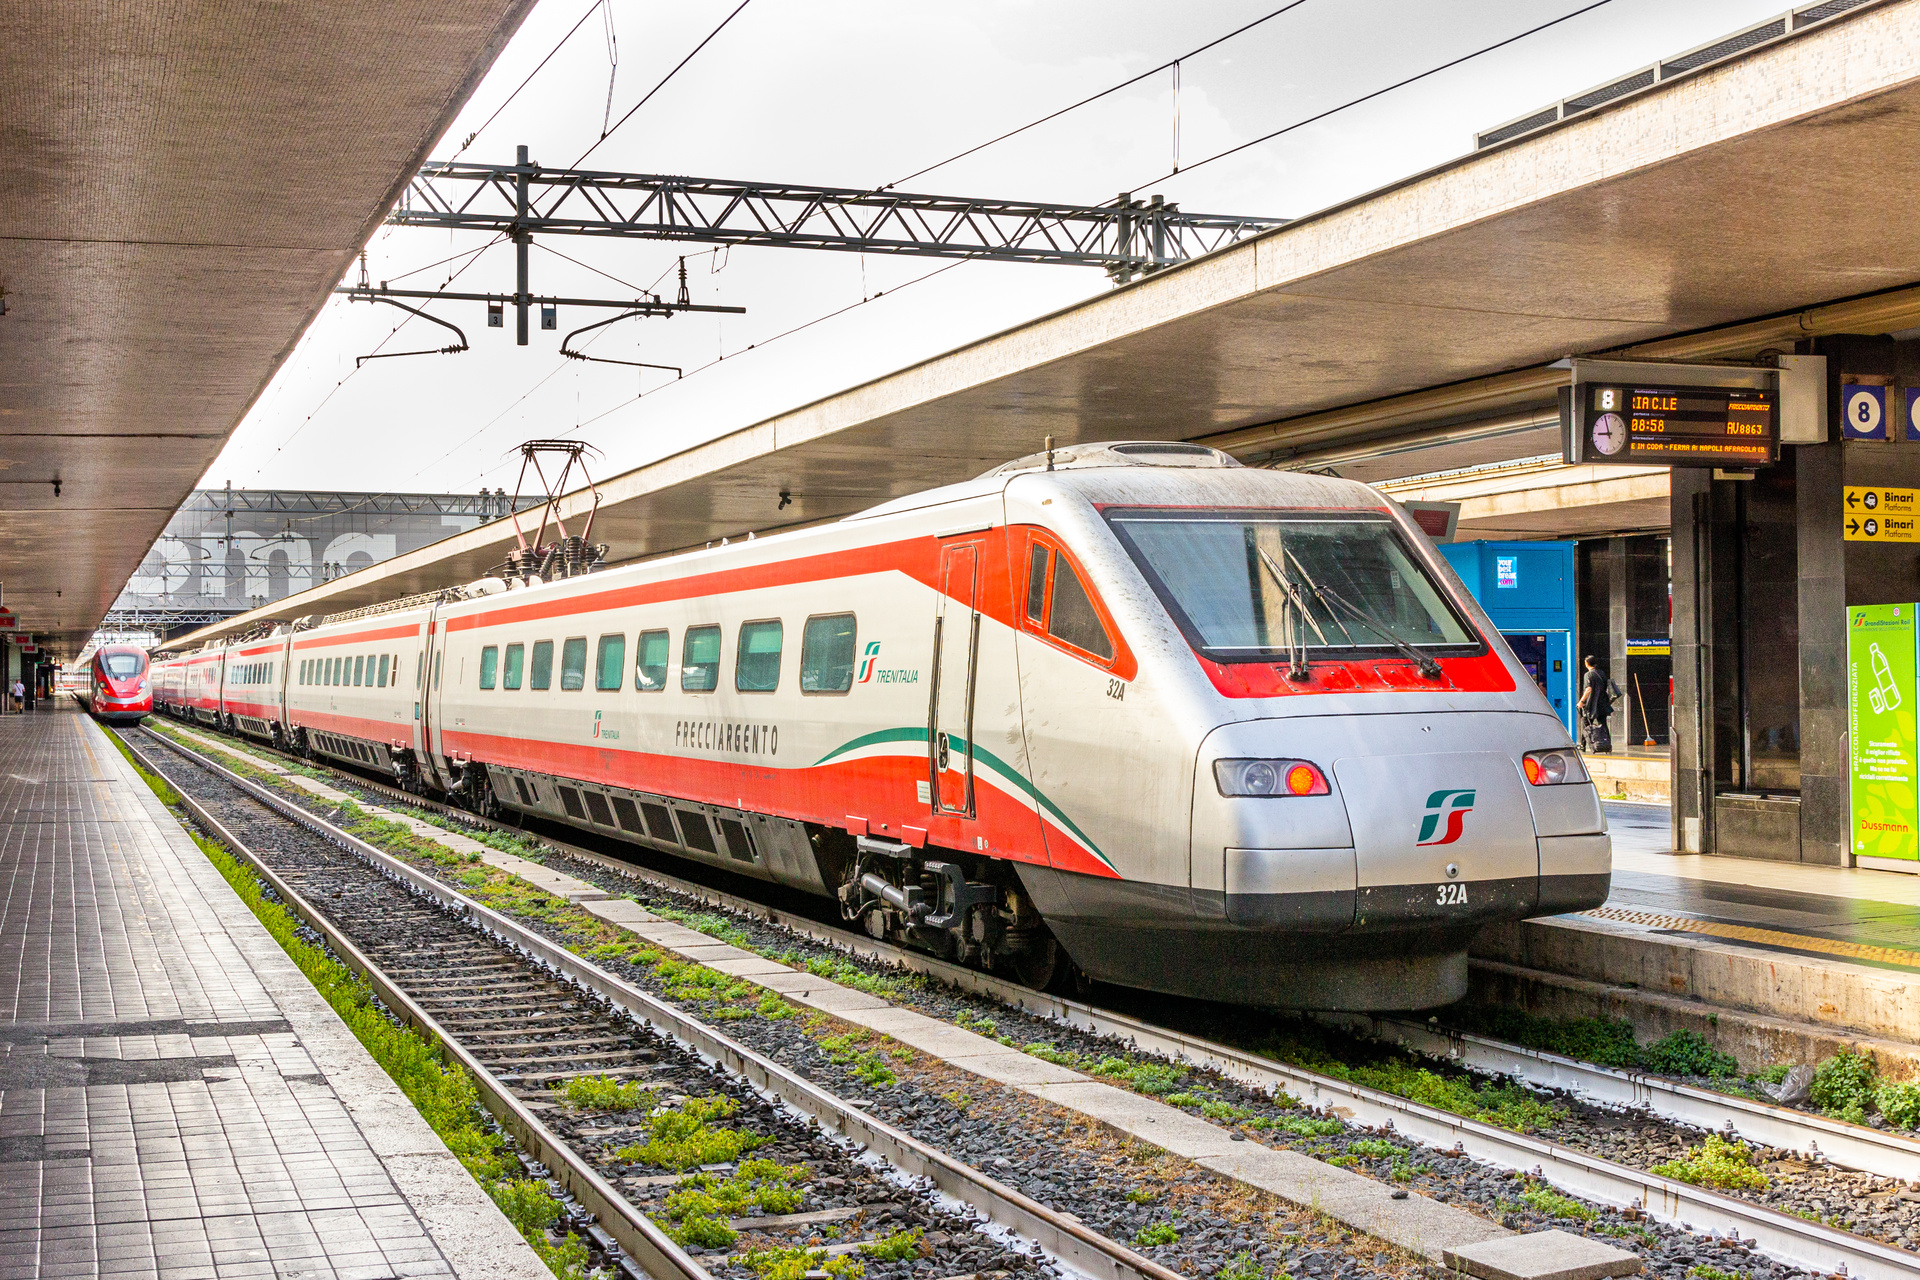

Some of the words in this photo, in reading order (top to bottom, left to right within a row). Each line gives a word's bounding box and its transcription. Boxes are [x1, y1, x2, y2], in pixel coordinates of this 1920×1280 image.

[493, 316, 499, 325] 3
[546, 319, 552, 327] 4
[1602, 390, 1614, 409] 8
[1651, 397, 1677, 411] C.LE
[1858, 401, 1871, 423] 8
[1631, 418, 1665, 432] 08:58
[1646, 442, 1664, 450] CODA
[1669, 443, 1690, 451] FERMA
[1699, 444, 1723, 452] NAPOLI
[1724, 445, 1757, 453] AFRAGOLA
[1884, 492, 1914, 502] Binari
[1884, 503, 1912, 511] Platforms
[1884, 518, 1914, 529] Binari
[1884, 529, 1912, 538] Platforms
[877, 669, 919, 684] TRENITALIA
[1106, 678, 1125, 701] 32A
[675, 720, 778, 755] FRECCIARGENTO
[1861, 819, 1909, 833] Dussmann
[1436, 883, 1468, 905] 32A
